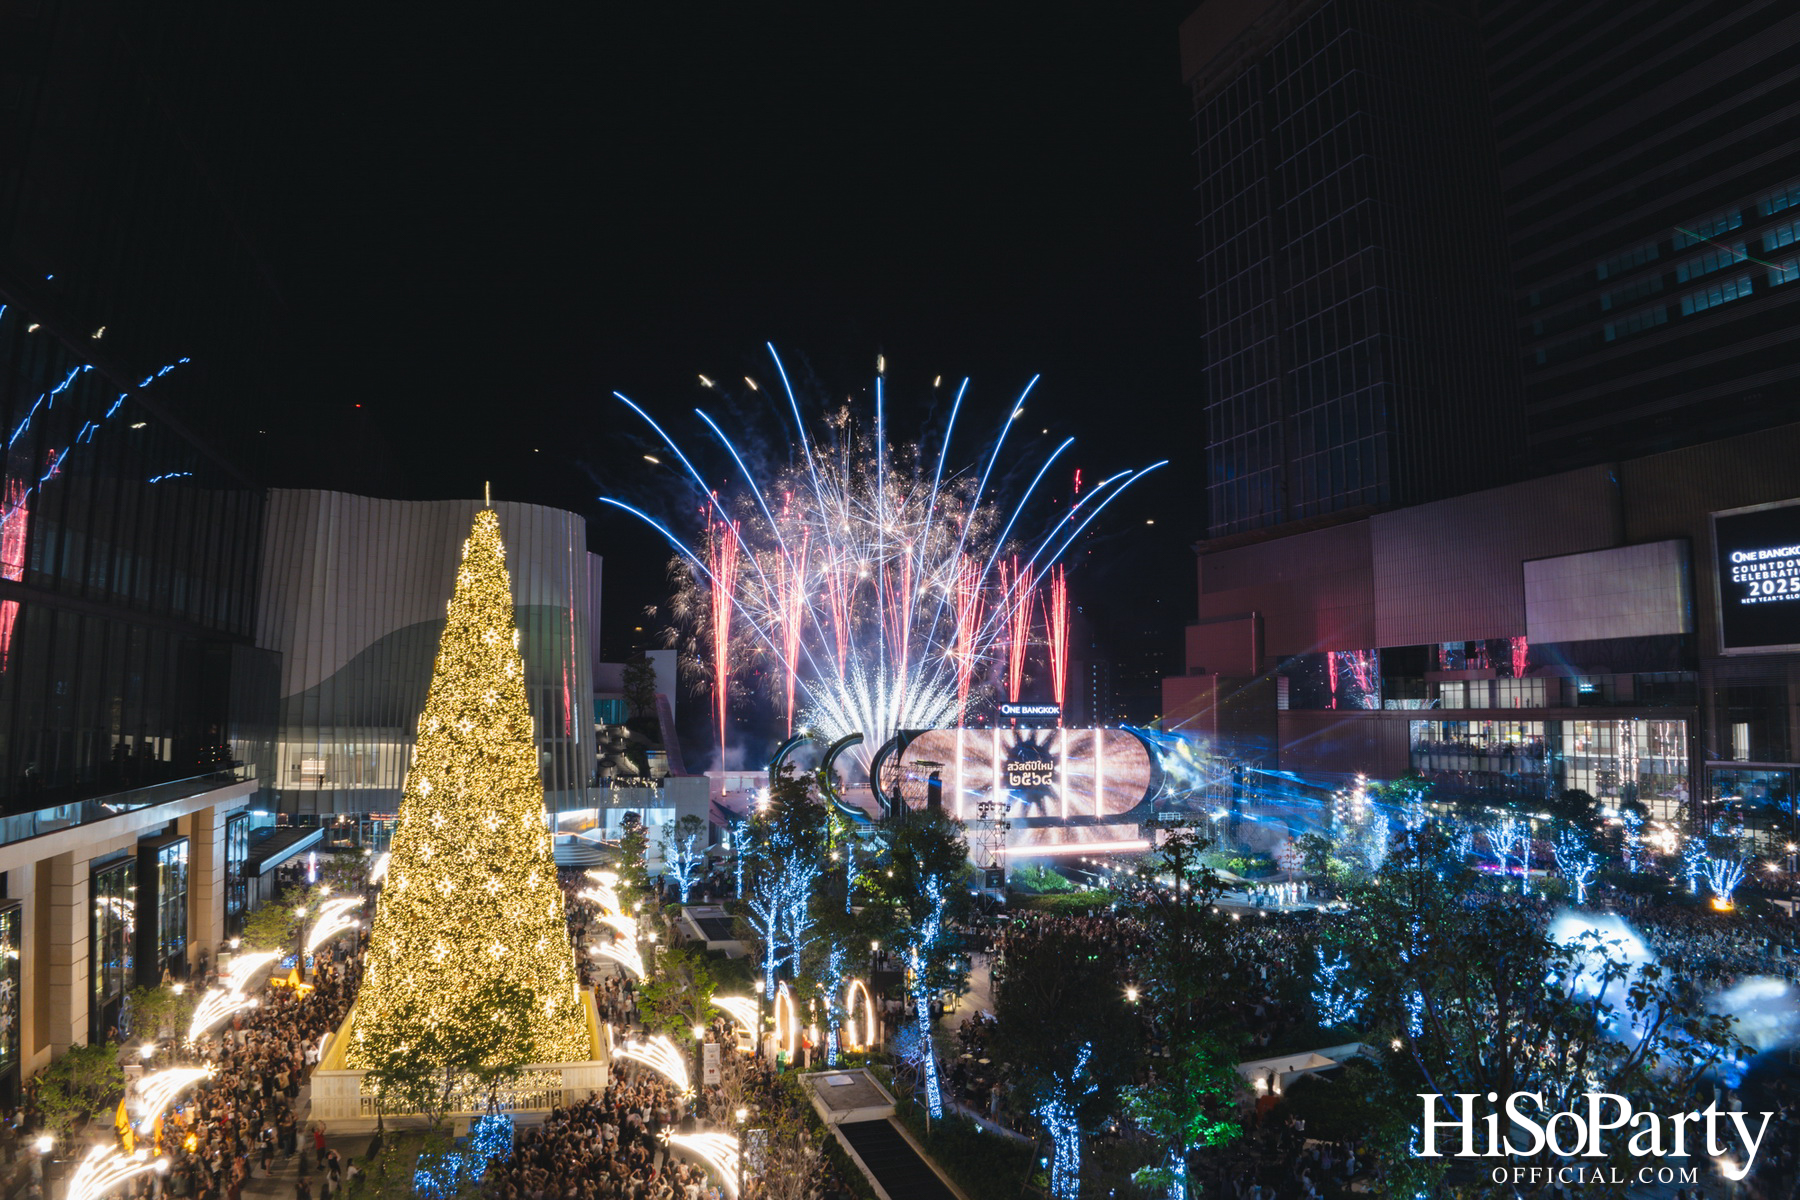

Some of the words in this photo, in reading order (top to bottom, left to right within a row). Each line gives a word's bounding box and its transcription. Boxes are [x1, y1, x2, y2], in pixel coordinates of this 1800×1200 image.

[1731, 551, 1758, 563] ONE
[1733, 568, 1800, 582] CELEBRATI
[1749, 577, 1800, 596] 2025
[1001, 704, 1021, 714] ONE
[1021, 706, 1060, 714] BANGKOK
[1007, 760, 1054, 772] สวัสดีปีใหม่
[1009, 772, 1053, 786] ๒๕๖๘
